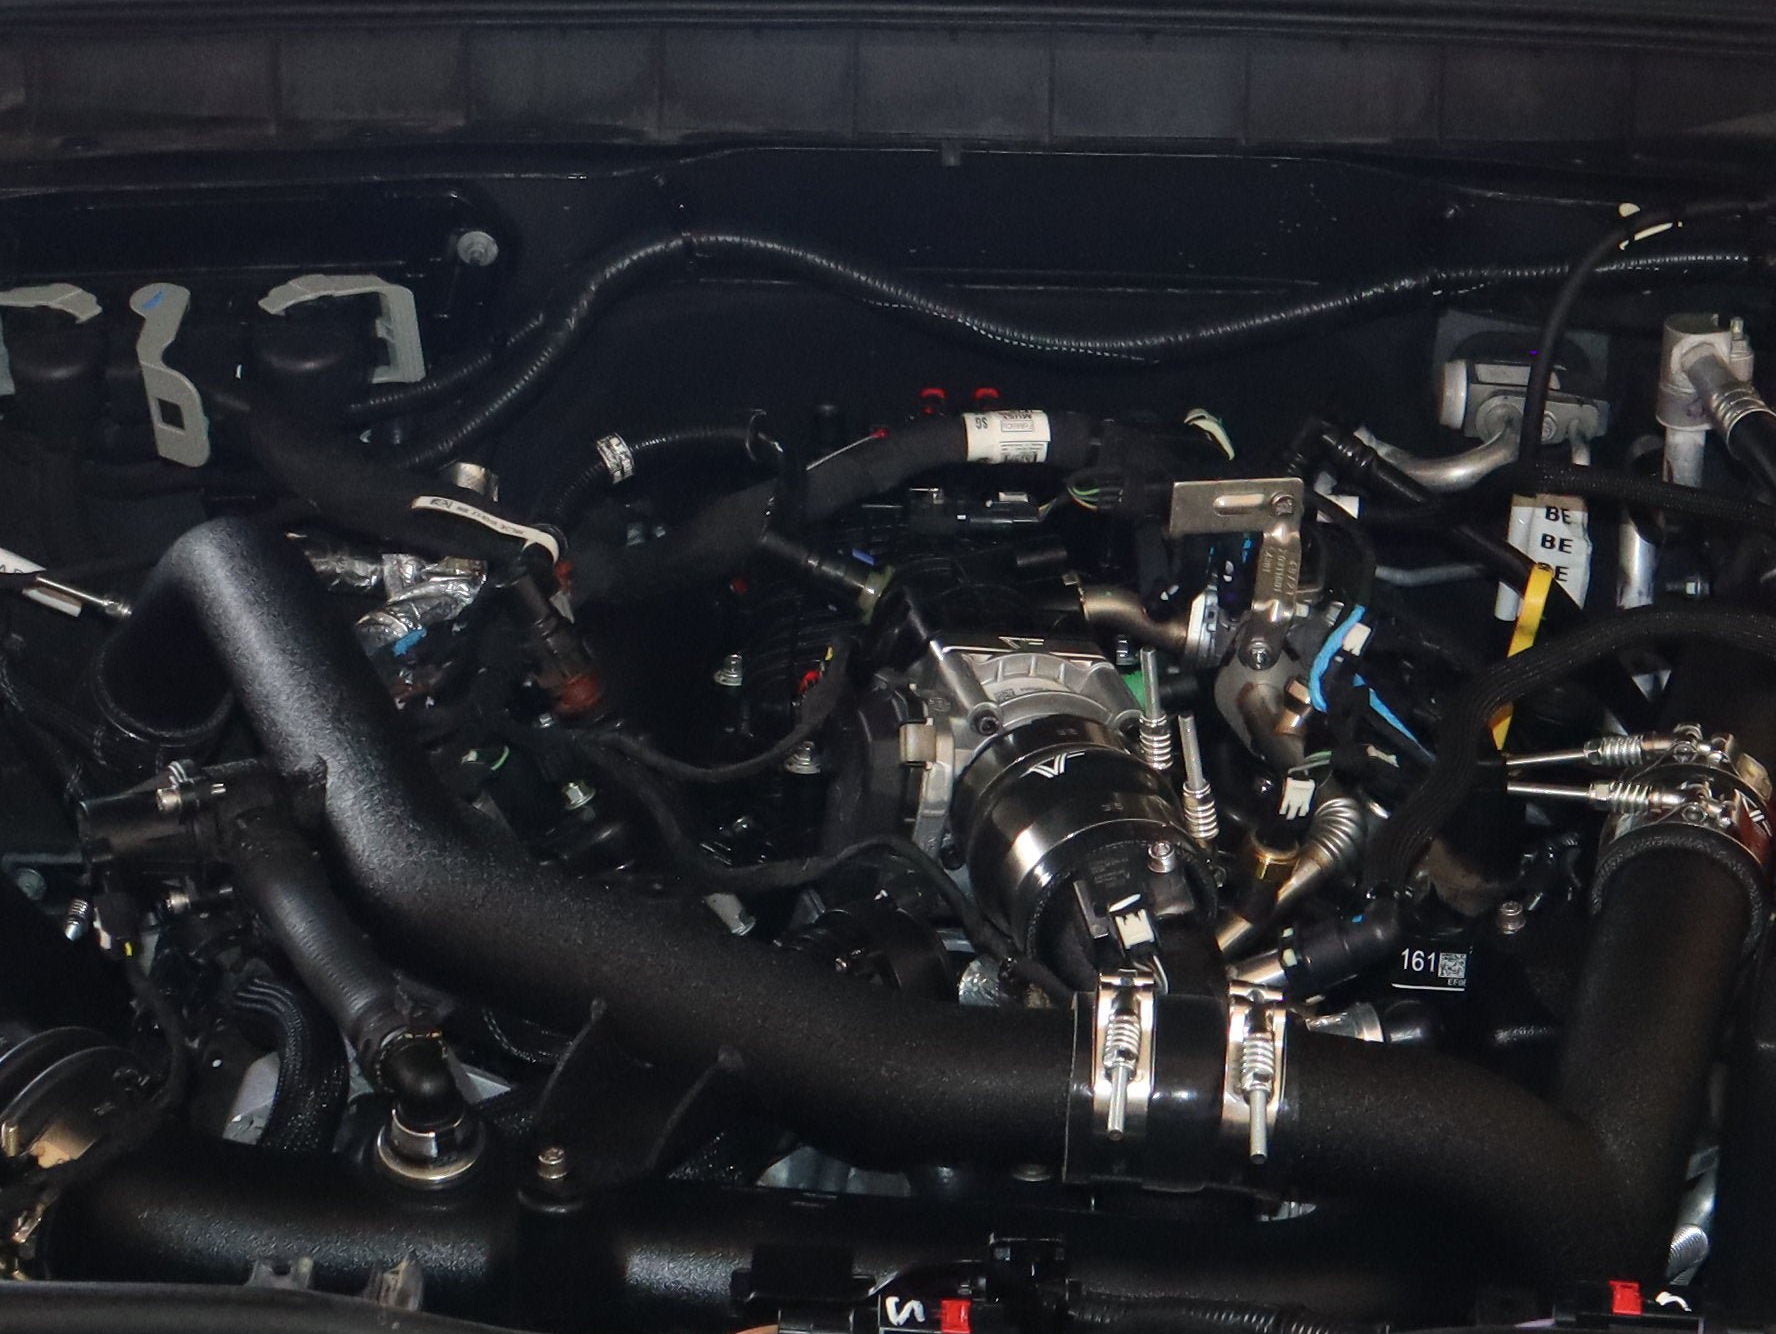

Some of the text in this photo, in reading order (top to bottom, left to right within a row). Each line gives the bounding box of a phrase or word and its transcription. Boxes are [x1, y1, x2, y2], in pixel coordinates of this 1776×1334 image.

[975, 416, 989, 429] SG
[1545, 505, 1572, 525] BE
[1540, 533, 1574, 554] BE
[1401, 948, 1436, 973] 161
